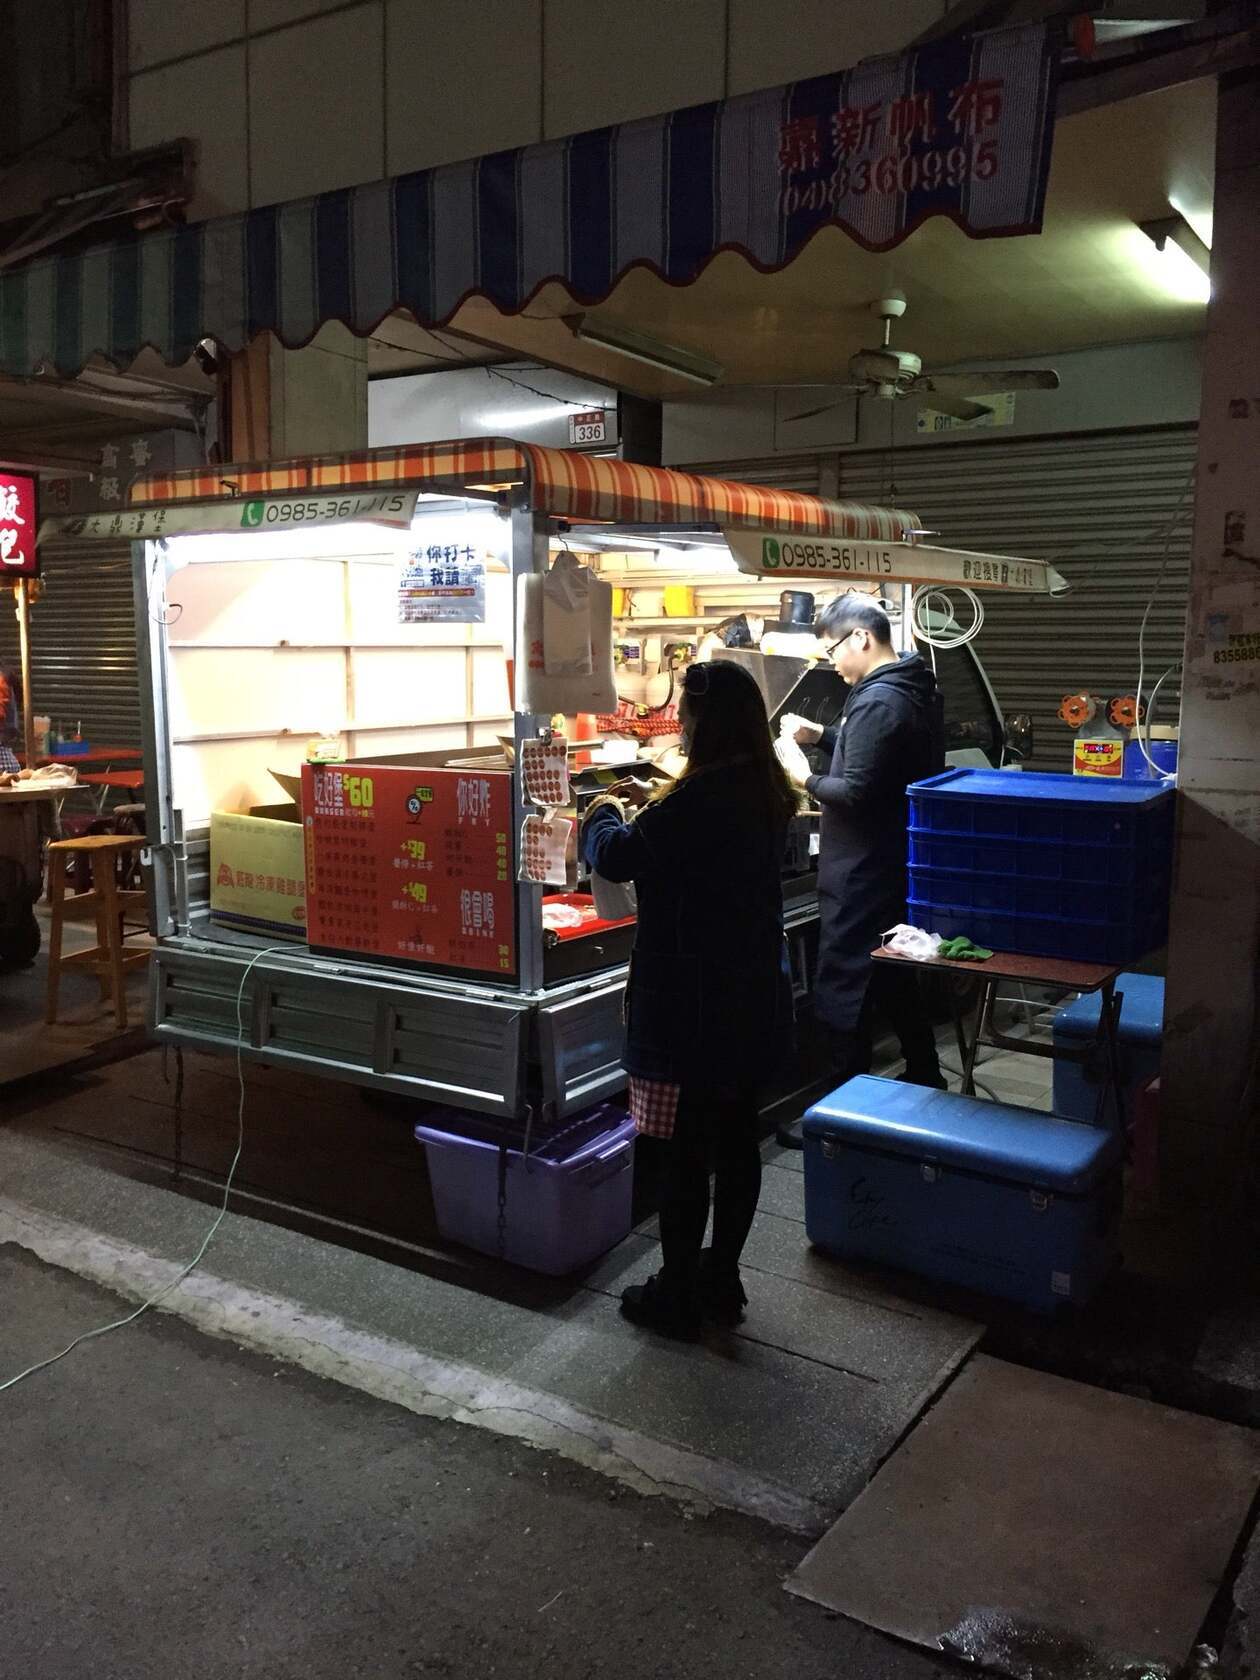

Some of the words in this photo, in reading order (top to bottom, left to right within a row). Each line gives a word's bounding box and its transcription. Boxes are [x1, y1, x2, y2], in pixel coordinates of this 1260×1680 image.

[579, 425, 601, 440] 336
[266, 495, 406, 523] 0985-361-115
[427, 543, 476, 563] 你打卡
[343, 773, 374, 808] $60
